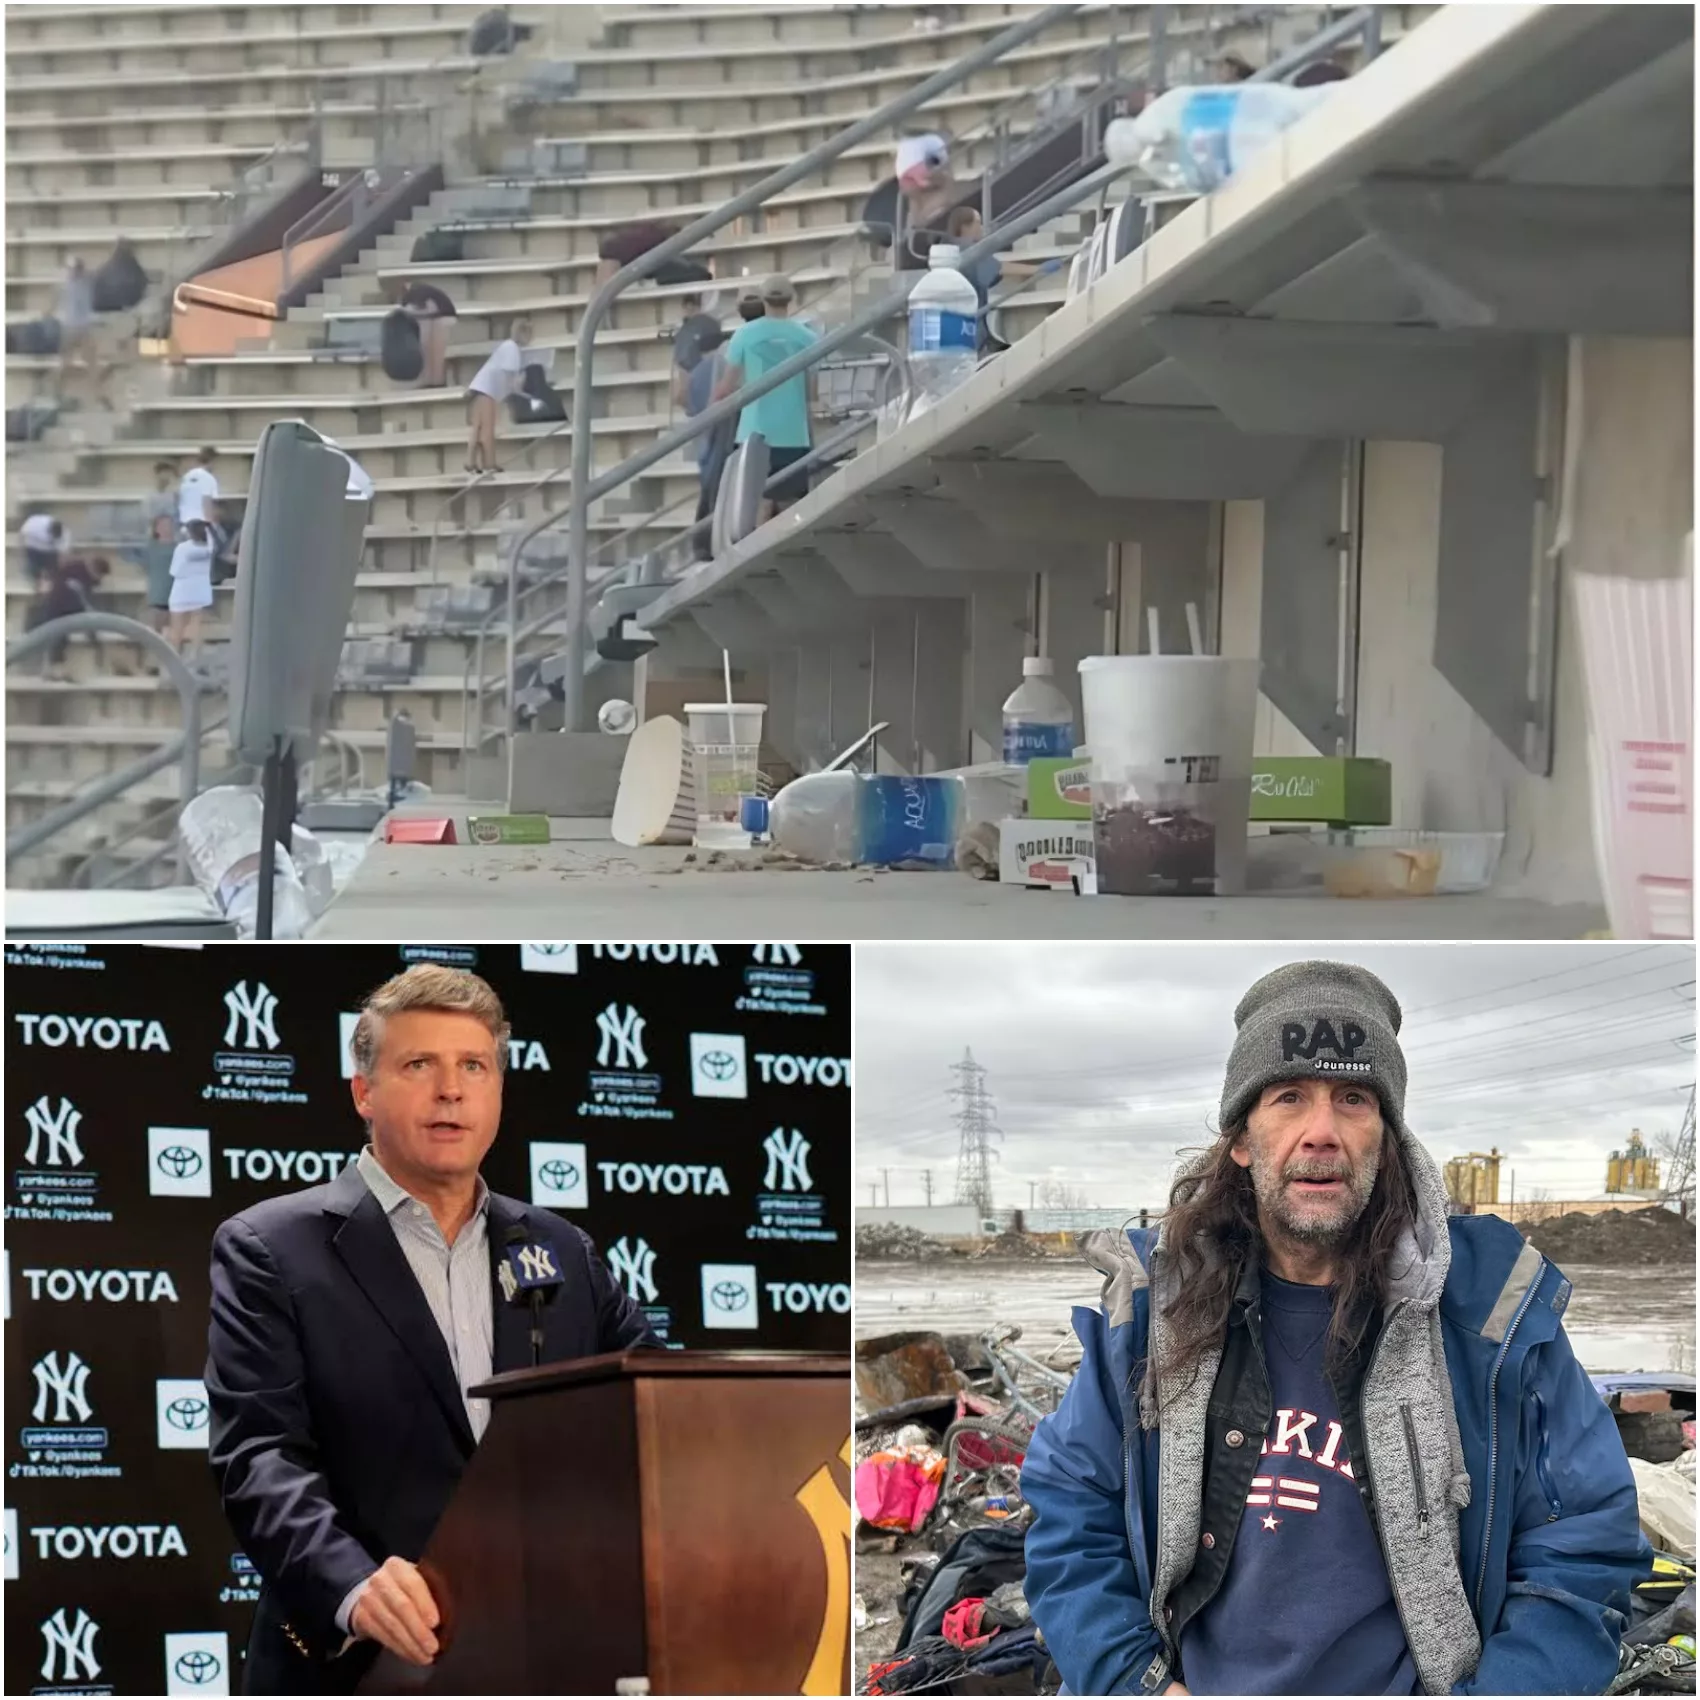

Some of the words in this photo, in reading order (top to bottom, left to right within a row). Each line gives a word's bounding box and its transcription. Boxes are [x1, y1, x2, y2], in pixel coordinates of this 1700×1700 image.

[16, 1015, 169, 1051] TOYOTA
[1282, 1018, 1365, 1061] RAP
[1314, 1060, 1372, 1072] Jeunesse
[223, 1148, 360, 1182] TOYOT
[598, 1163, 729, 1195] TOYOTA
[23, 1269, 178, 1302] TOYOTA
[1260, 1408, 1355, 1480] KI
[31, 1526, 187, 1558] TOYOTA
